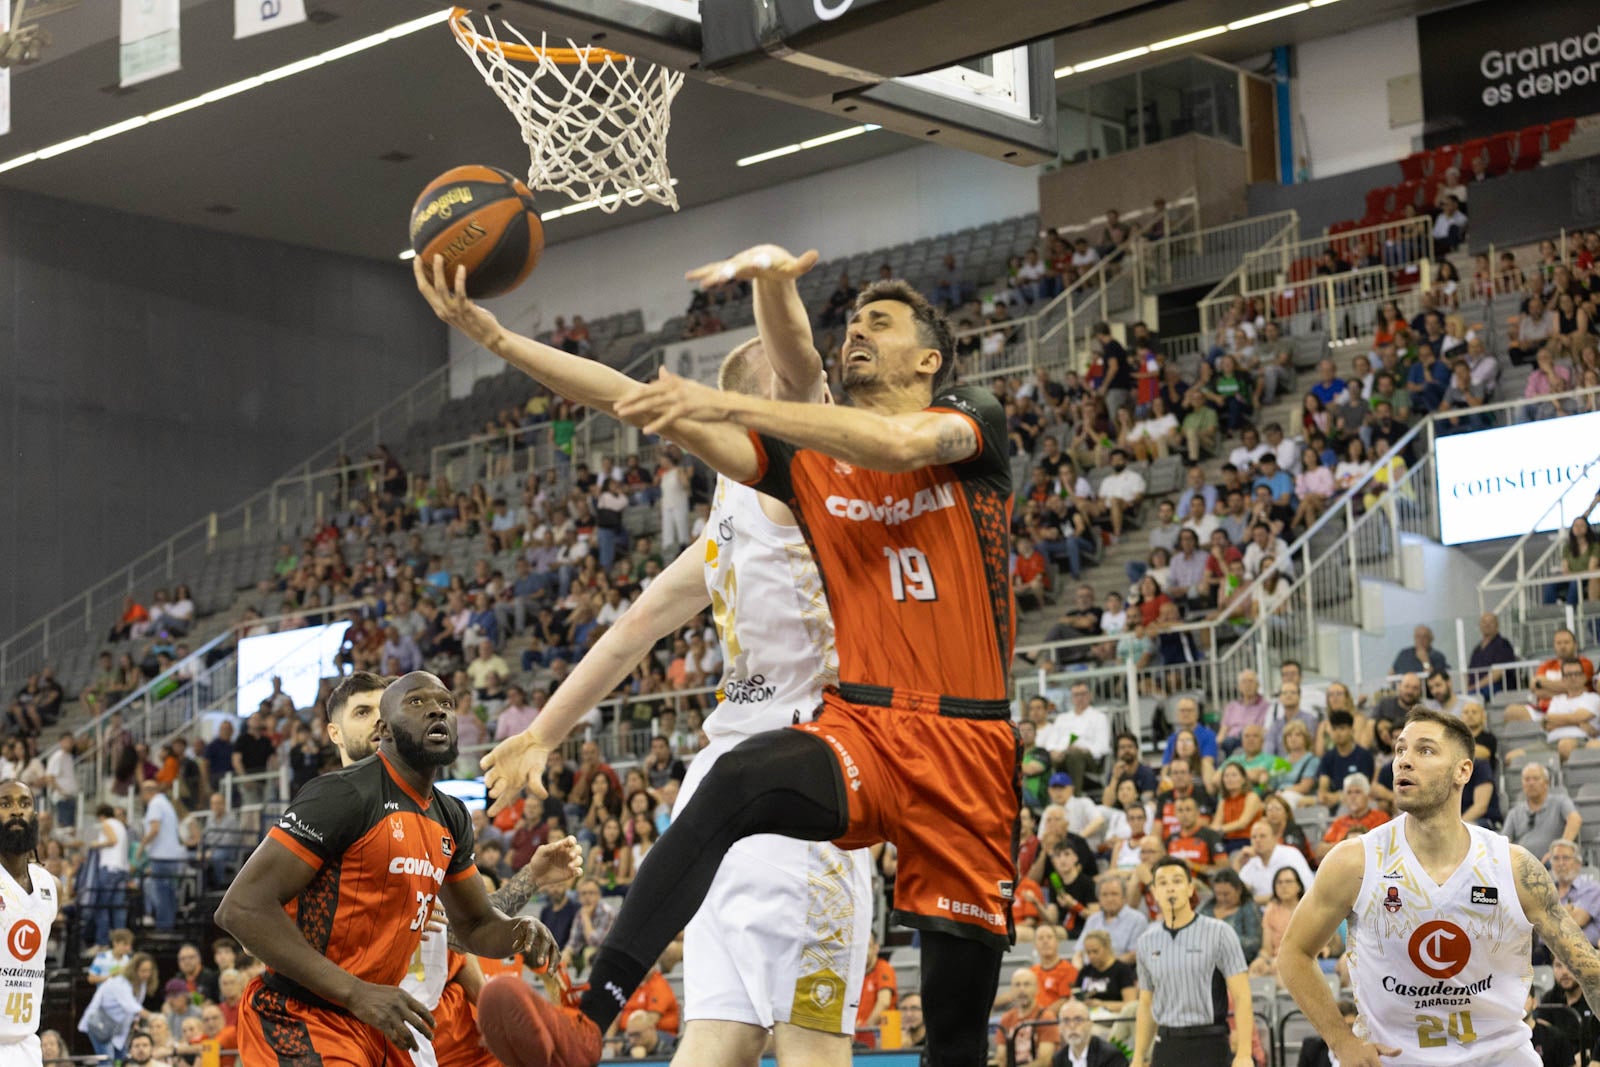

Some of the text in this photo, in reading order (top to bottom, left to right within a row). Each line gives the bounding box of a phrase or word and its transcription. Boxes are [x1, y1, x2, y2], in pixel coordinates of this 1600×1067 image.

[1482, 83, 1513, 106] es
[883, 546, 938, 602] 19
[1382, 973, 1493, 997] Casademont
[5, 991, 33, 1025] 45
[1414, 998, 1471, 1009] ZARAGOZA
